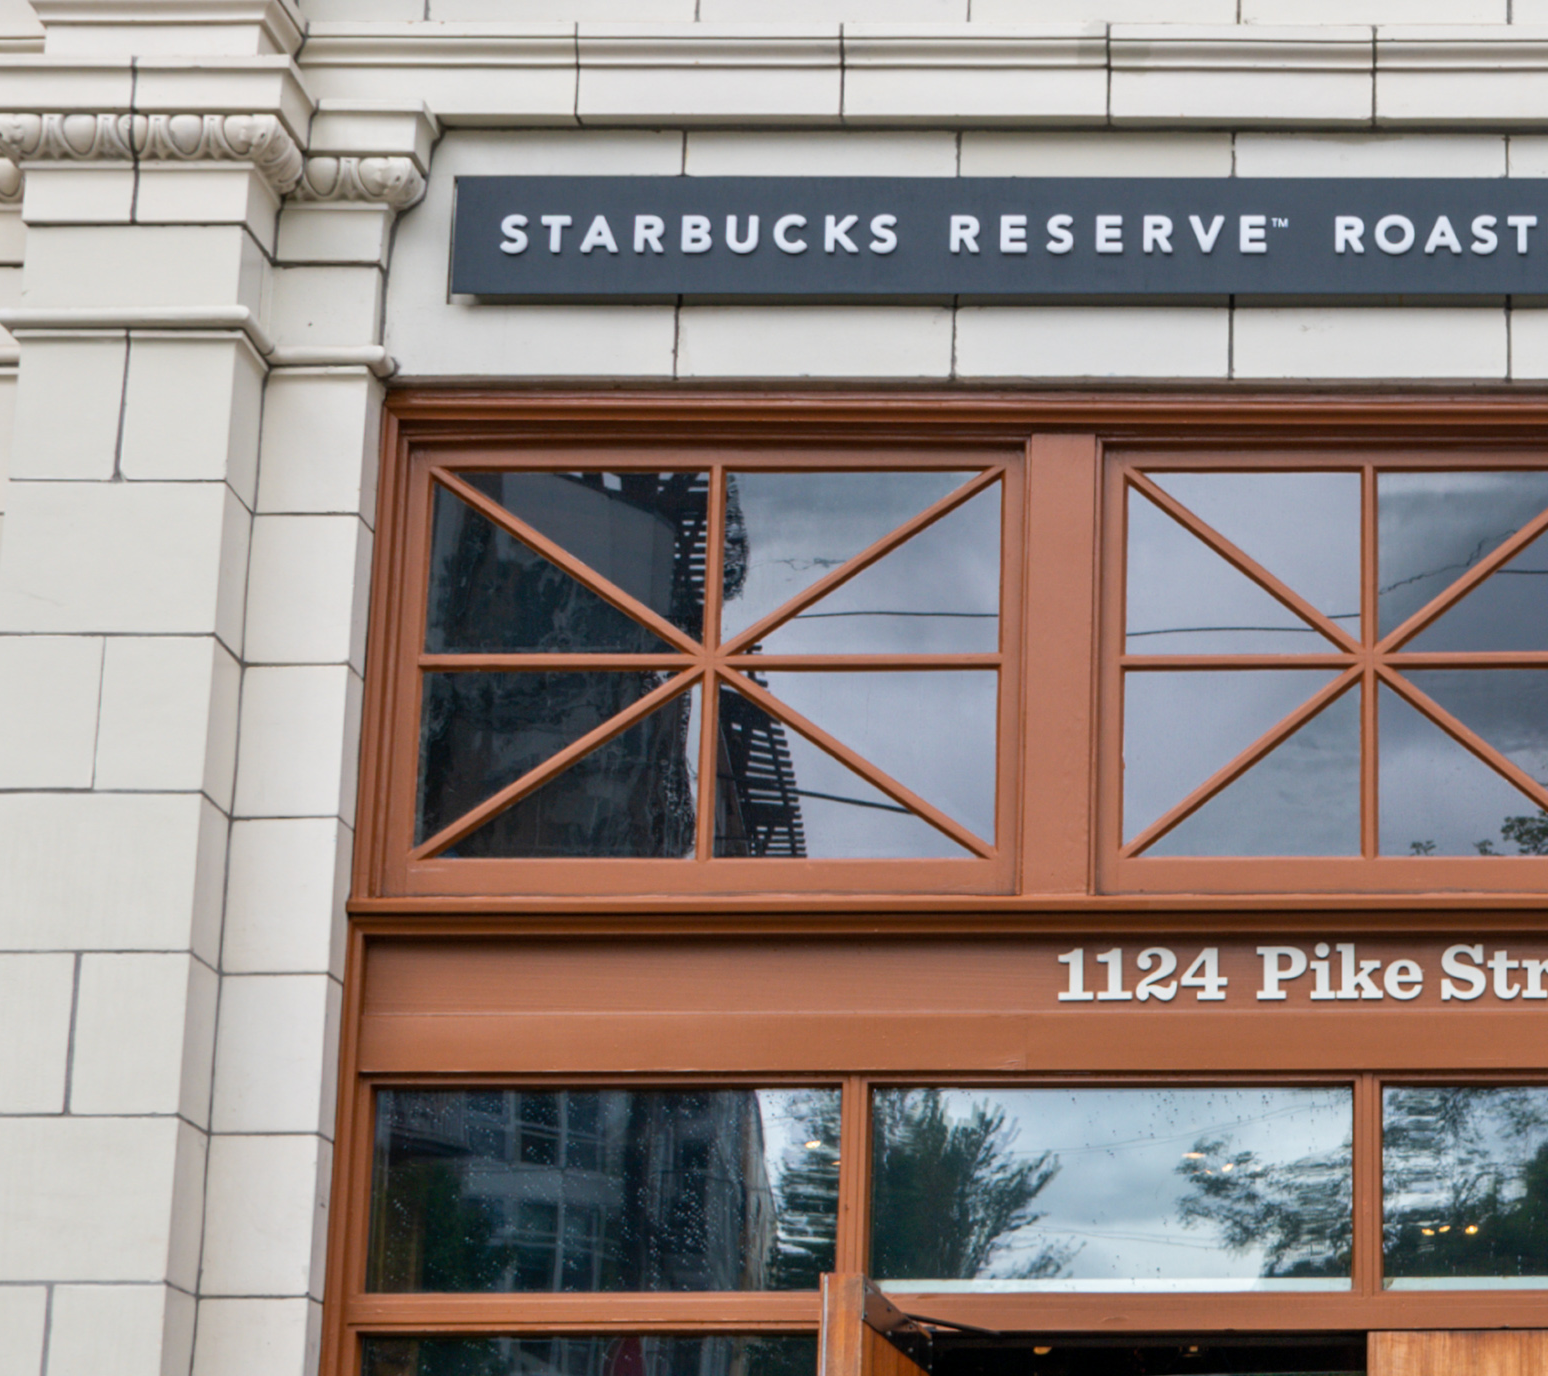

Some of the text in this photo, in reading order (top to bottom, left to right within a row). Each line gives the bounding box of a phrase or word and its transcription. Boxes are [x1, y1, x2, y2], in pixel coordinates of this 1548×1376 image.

[499, 213, 898, 254] STARBUCKS
[1057, 946, 1228, 1001] 1124
[1256, 942, 1423, 1000] Pike
